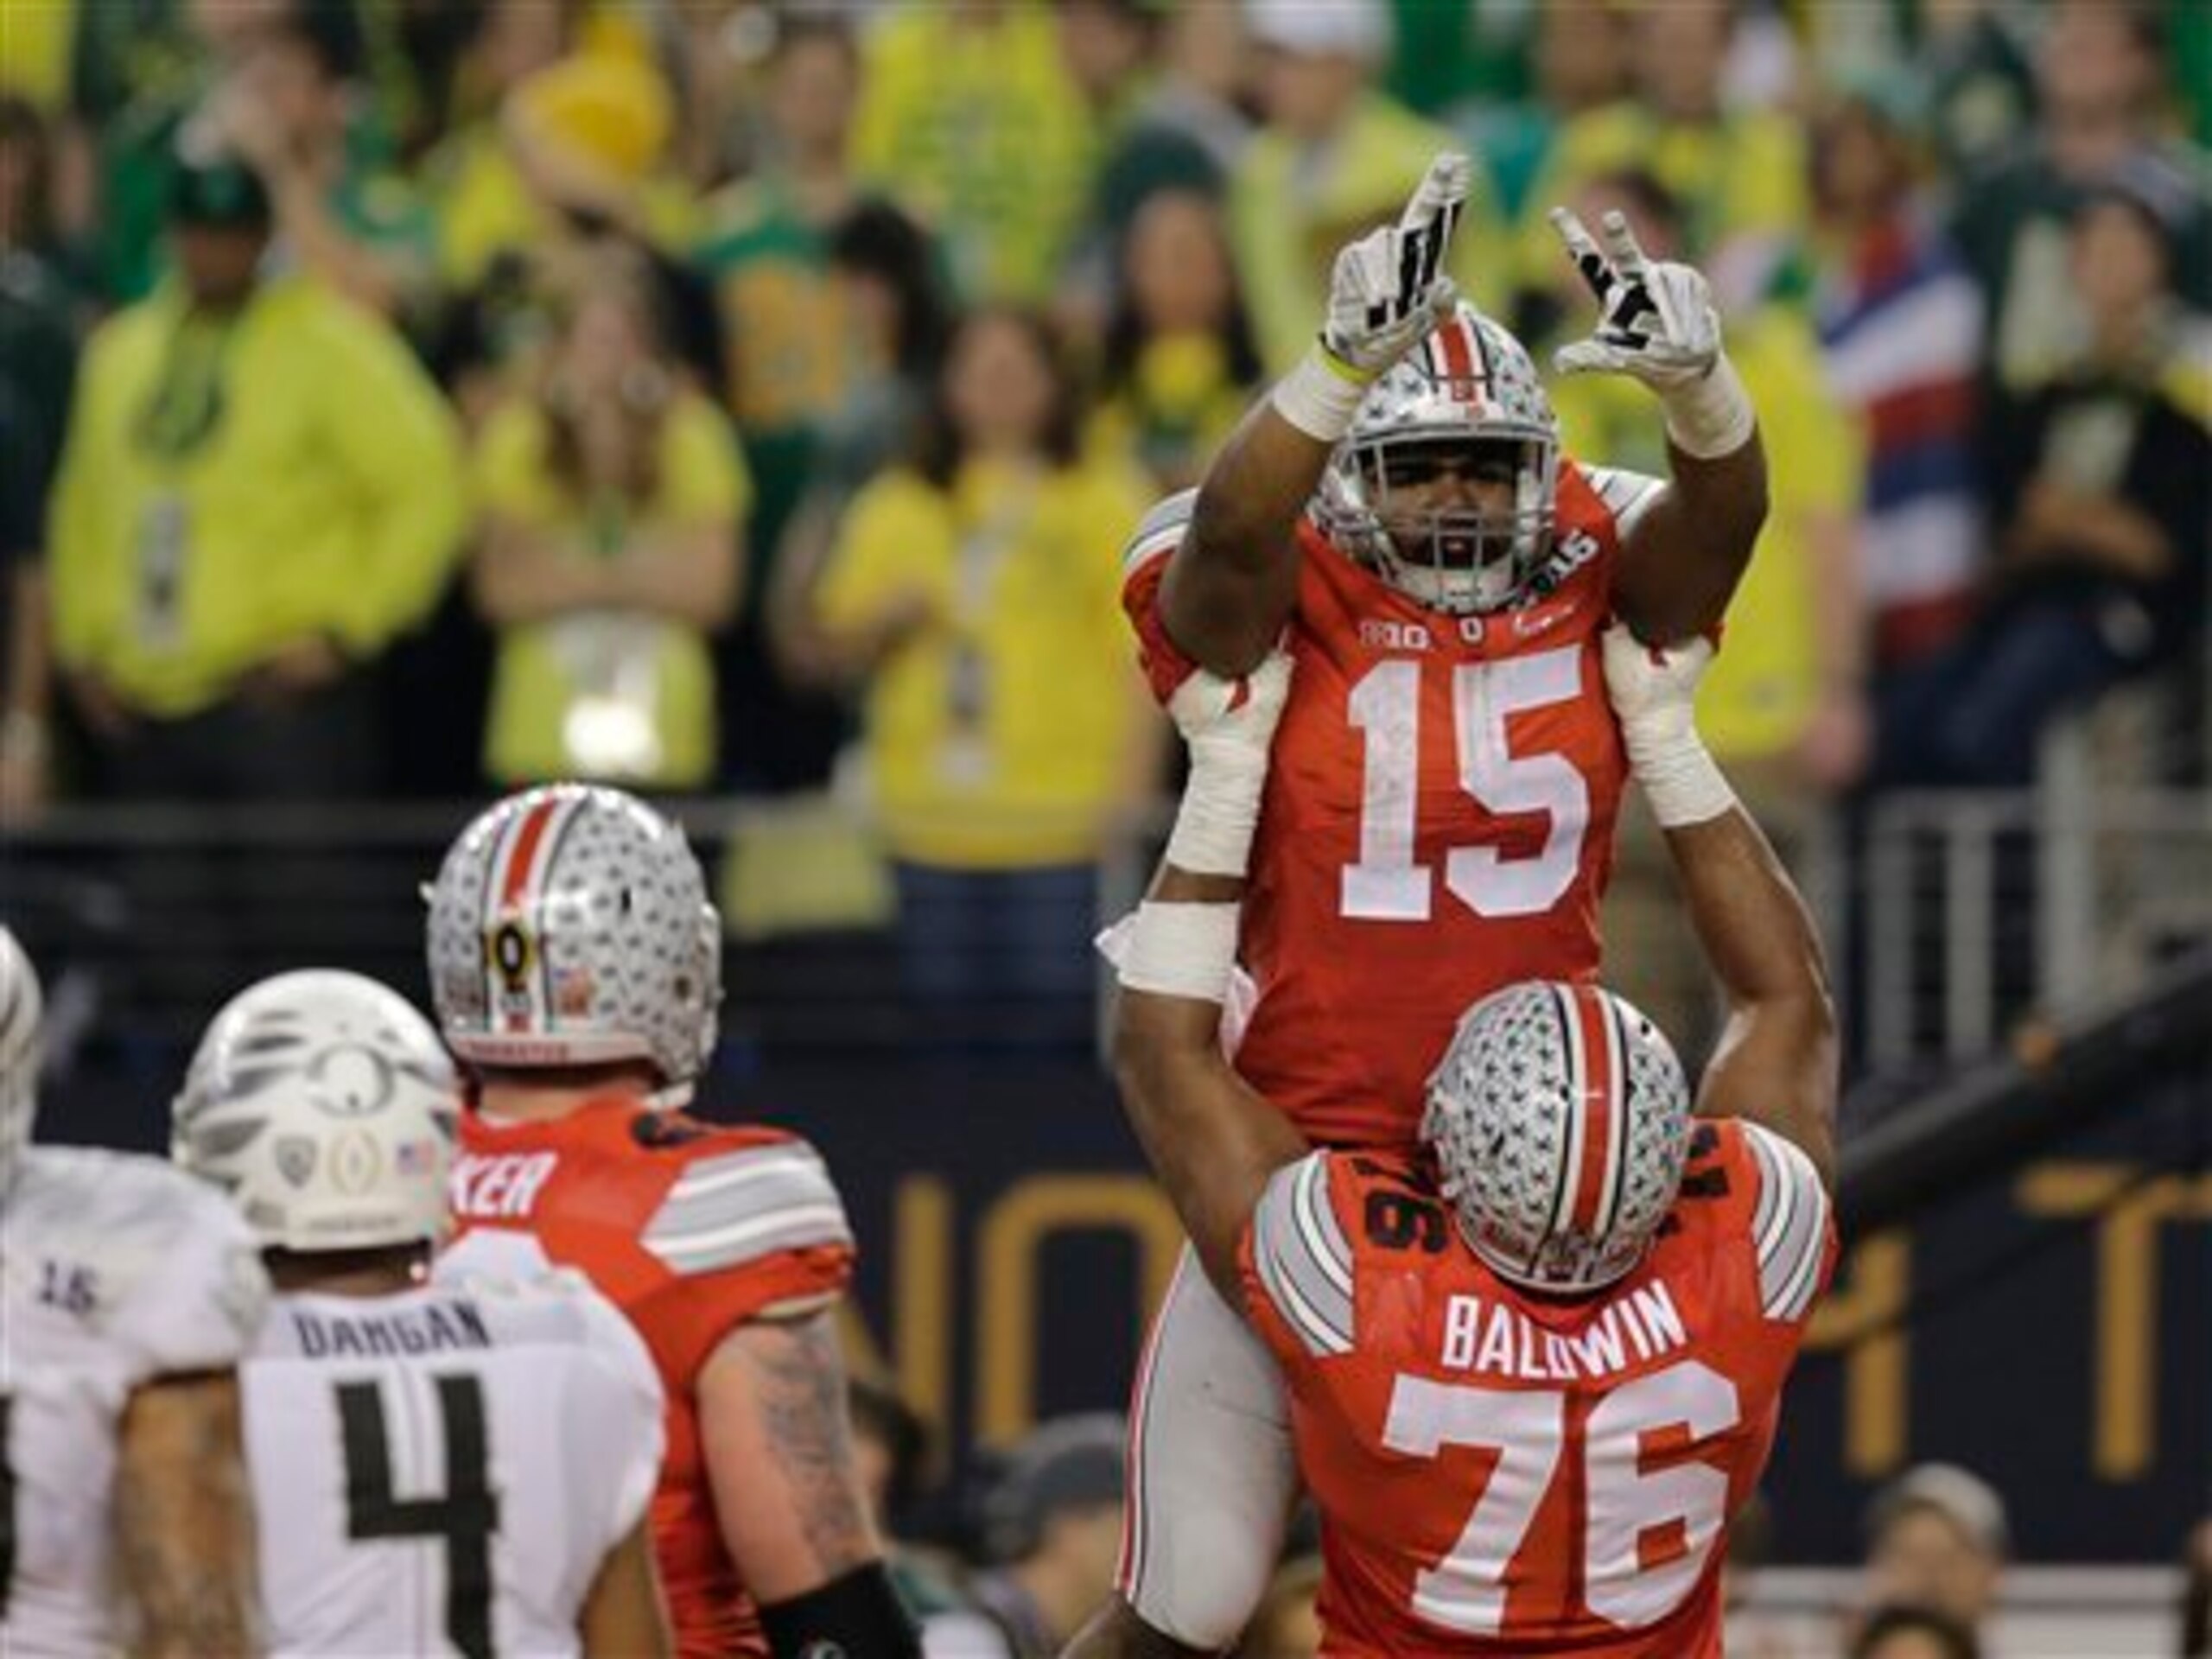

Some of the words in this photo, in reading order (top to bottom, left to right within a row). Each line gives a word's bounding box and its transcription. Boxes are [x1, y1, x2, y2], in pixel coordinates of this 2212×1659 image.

[1340, 644, 1590, 921] 15
[1441, 1279, 1688, 1380] BALDWIN
[334, 1372, 501, 1659] 4
[1382, 1358, 1742, 1638] 76
